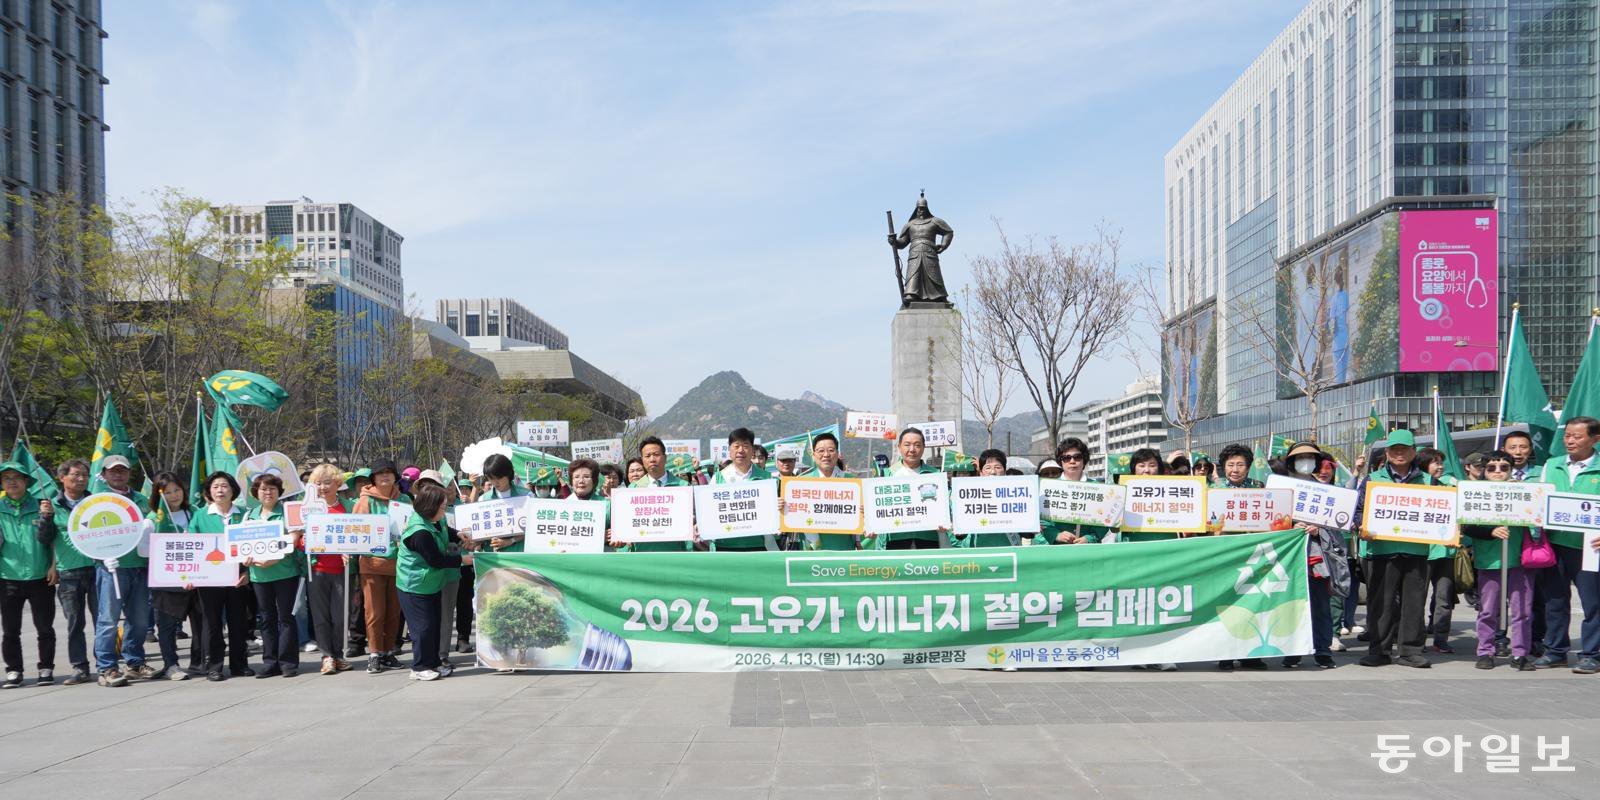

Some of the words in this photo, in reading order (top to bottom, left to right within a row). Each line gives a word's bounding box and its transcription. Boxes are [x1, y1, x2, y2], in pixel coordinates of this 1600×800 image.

[1422, 258, 1448, 270] 종로,
[1422, 270, 1466, 282] 요양에서
[713, 491, 731, 500] 작은
[732, 488, 760, 500] 실천이
[792, 489, 822, 500] 범국민
[824, 490, 854, 500] 에너지
[874, 484, 911, 495] 대중교통
[958, 488, 992, 500] 아끼는
[996, 486, 1032, 498] 에너지,
[1044, 488, 1070, 500] 안쓰는
[1072, 491, 1104, 502] 전기제품
[1132, 486, 1165, 498] 고유가
[1168, 487, 1194, 498] 극복!
[630, 495, 674, 504] 새마을회가
[875, 496, 912, 507] 이용으로
[1298, 491, 1336, 506] 중교통
[1376, 494, 1422, 507] 대기전력
[1424, 498, 1452, 510] 차단,
[1464, 491, 1492, 500] 안쓰는
[1495, 492, 1532, 502] 전기제품
[634, 506, 670, 516] 앞장서는
[718, 502, 727, 512] 큰
[730, 500, 756, 511] 변화를
[788, 502, 812, 514] 절약,
[814, 504, 856, 514] 함께해요!
[876, 508, 904, 518] 에너지
[906, 506, 928, 516] 절약!
[964, 504, 998, 514] 지키는
[1002, 502, 1027, 514] 미래!
[1132, 502, 1164, 513] 에너지
[1168, 502, 1194, 513] 절약!
[1296, 502, 1333, 518] 용하기
[536, 509, 558, 521] 생활
[560, 510, 570, 521] 속
[572, 510, 596, 522] 절약,
[719, 512, 757, 524] 만듭니다!
[1374, 508, 1420, 522] 전기요금
[1424, 512, 1450, 524] 절감!
[632, 518, 650, 528] 절약
[652, 518, 672, 528] 실천!
[536, 524, 567, 536] 모두의
[570, 525, 594, 536] 실천!
[165, 541, 204, 551] 불필요한
[165, 552, 194, 561] 전등은
[164, 564, 174, 572] 꼭
[178, 564, 200, 572] 끄기!
[811, 564, 846, 576] Save
[849, 564, 900, 579] Energy,
[904, 563, 939, 576] Save
[942, 562, 980, 575] Earth
[620, 598, 719, 633] 2026
[730, 595, 844, 634] 고유가
[856, 594, 970, 634] 에너지
[984, 591, 1063, 630] 절약
[1074, 584, 1193, 628] 캠페인
[735, 653, 775, 666] 2026.
[779, 654, 792, 666] 4.
[847, 653, 885, 666] 14:30
[902, 650, 966, 665] 광화문광장
[1008, 646, 1120, 664] 새마을운동중앙회
